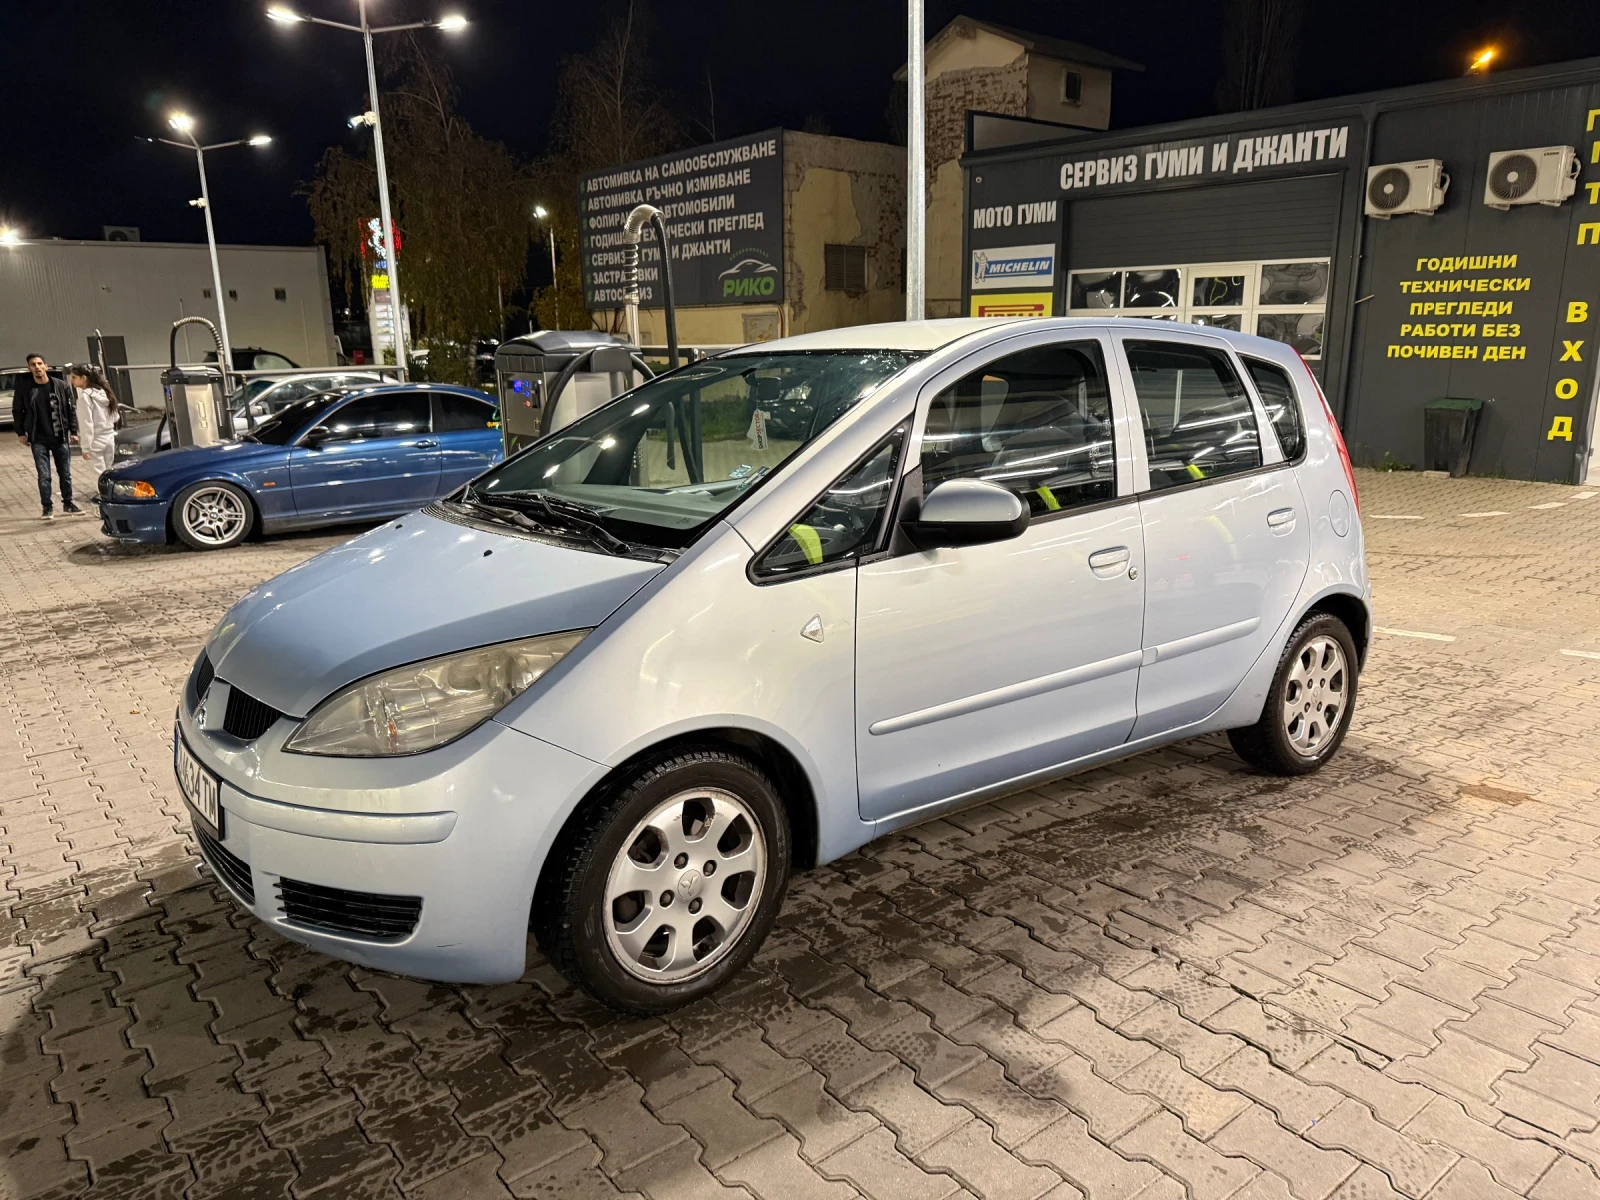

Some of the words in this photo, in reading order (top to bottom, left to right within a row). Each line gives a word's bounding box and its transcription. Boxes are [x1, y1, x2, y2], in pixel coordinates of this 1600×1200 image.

[586, 169, 643, 193] АВТОМИВКА
[645, 165, 659, 181] НА
[661, 139, 776, 178] САМООБСЛУЖВАНЕ
[1060, 154, 1137, 190] СЕРВИЗ
[1144, 146, 1204, 181] ГУМИ
[1211, 142, 1228, 172] И
[1232, 126, 1348, 174] ДЖАНТИ
[587, 189, 644, 212] АВТОМИВКА
[646, 181, 683, 201] РЪЧНО
[687, 168, 751, 194] ИЗМИВАНЕ
[589, 210, 629, 230] ФОЛИРА
[973, 204, 1013, 230] МОТО
[1017, 201, 1057, 225] ГУМИ
[590, 230, 625, 249] ГОДИШ
[708, 211, 764, 234] ПРЕГЛЕД
[591, 250, 626, 267] СЕРВИЗ
[642, 246, 661, 263] ГУМ
[671, 244, 680, 259] И
[682, 238, 731, 261] ДЖАНТИ
[989, 260, 1050, 274] MICHELIN
[1416, 254, 1518, 272] ГОДИШНИ
[592, 267, 658, 285] ЗАСТРАВКИ
[1399, 277, 1531, 294] ТЕХНИЧЕСКИ
[594, 287, 653, 303] АВТОСИЗ
[722, 276, 775, 298] РИКО
[1409, 301, 1513, 317] ПРЕГЛЕДИ
[1400, 323, 1477, 337] РАБОТИ
[1482, 323, 1521, 337] БЕЗ
[1387, 345, 1477, 360] ПОЧИВЕН
[1482, 345, 1526, 361] ДЕН
[1547, 301, 1588, 441] ВХОД
